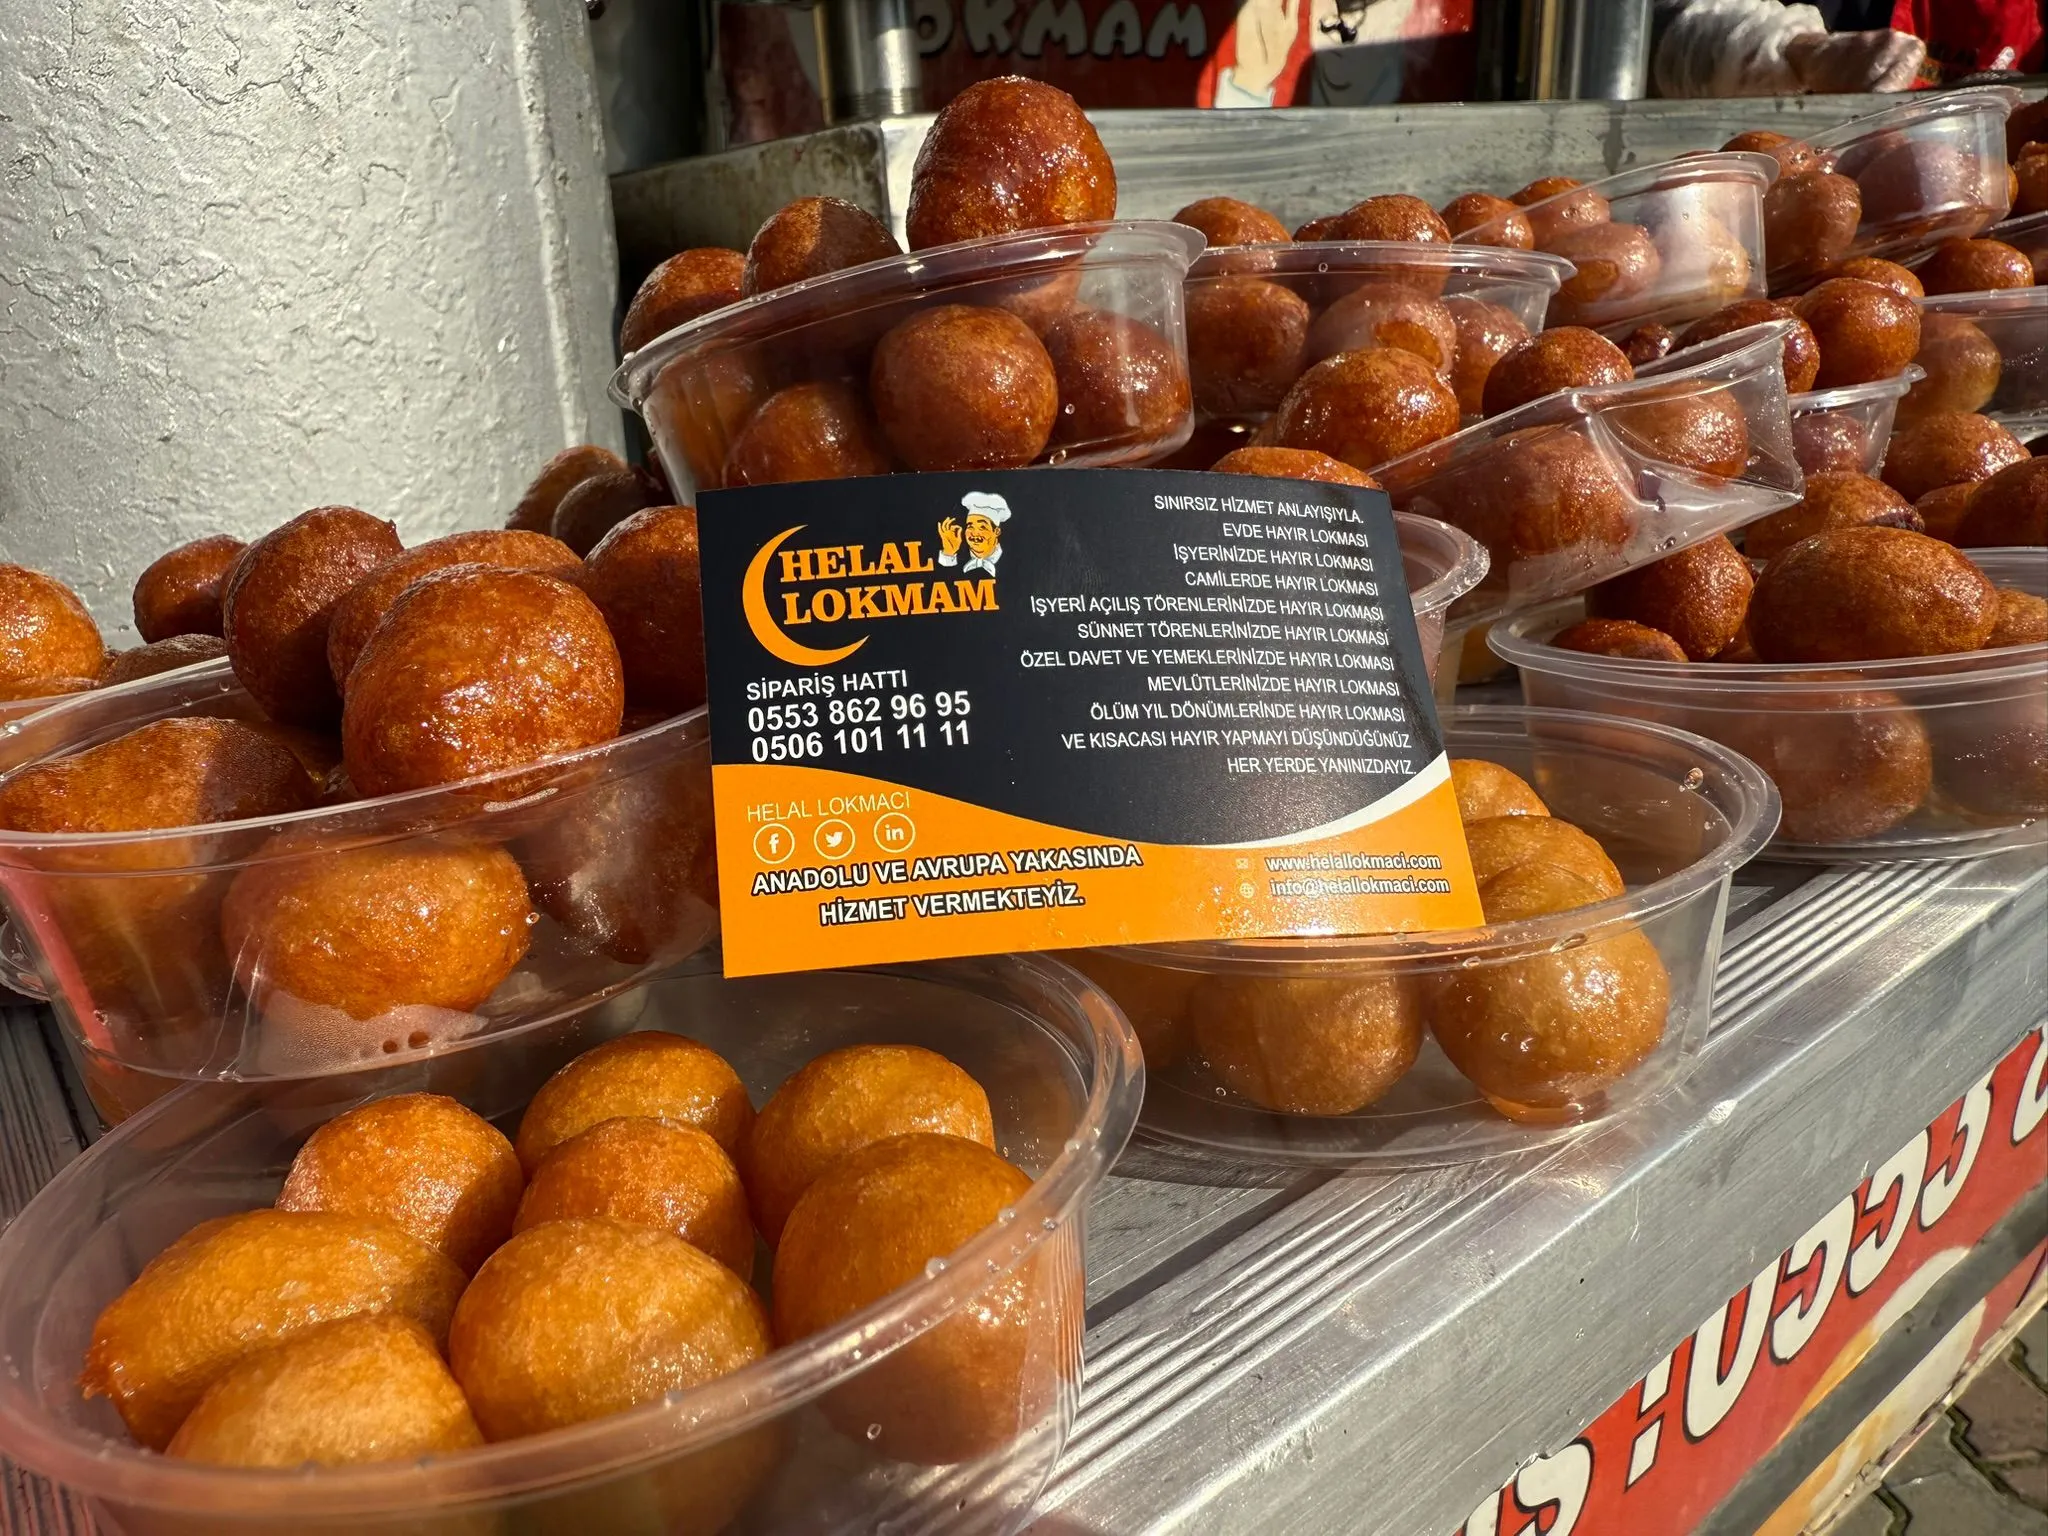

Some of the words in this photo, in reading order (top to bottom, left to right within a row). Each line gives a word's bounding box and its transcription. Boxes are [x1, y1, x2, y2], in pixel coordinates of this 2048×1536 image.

[1154, 495, 1219, 512] SINIRSIZ
[1221, 496, 1274, 515] HİZMET
[1277, 502, 1364, 524] ANLAYIŞIYLA.
[1223, 522, 1263, 539] EVDE
[1266, 525, 1308, 542] HAYIR
[1310, 529, 1369, 548] LOKMASI
[777, 541, 934, 583] HELAL
[1173, 543, 1268, 564] İŞYERİNİZDE
[1270, 551, 1313, 567] HAYIR
[1315, 554, 1374, 572] LOKMASI
[1185, 570, 1272, 589] CAMİLERDE
[1275, 575, 1317, 592] HAYIR
[1320, 578, 1379, 597] LOKMASI
[781, 578, 1000, 625] LOKMAM
[1030, 595, 1086, 617] İŞYERİ
[1089, 596, 1141, 615] AÇILIŞ
[1143, 594, 1277, 615] TÖRENLERİNİZDE
[1279, 600, 1323, 617] HAYIR
[1325, 603, 1384, 621] LOKMASI
[1077, 621, 1144, 639] SÜNNET
[1147, 620, 1282, 640] TÖRENLERİNİZDE
[1284, 626, 1328, 642] HAYIR
[1330, 628, 1390, 646] LOKMASI
[1020, 650, 1066, 668] ÖZEL
[1068, 650, 1122, 666] DAVET
[1125, 649, 1149, 665] VE
[1152, 648, 1287, 666] YEMEKLERİNİZDE
[1289, 651, 1333, 668] HAYIR
[1334, 653, 1395, 671] LOKMASI
[746, 672, 836, 701] SİPARİŞ
[842, 669, 908, 693] HATTI
[1147, 673, 1292, 692] MEVLÜTLERİNİZDE
[1294, 678, 1338, 694] HAYIR
[1340, 680, 1400, 697] LOKMASI
[747, 701, 819, 733] 0553
[829, 696, 882, 725] 862
[890, 693, 926, 720] 96
[935, 690, 971, 717] 95
[1090, 702, 1139, 720] ÖLÜM
[1141, 703, 1168, 719] YIL
[1171, 701, 1296, 719] DÖNÜMLERİNDE
[1299, 704, 1343, 720] HAYIR
[1345, 705, 1406, 722] LOKMASI
[751, 731, 823, 763] 0506
[833, 726, 883, 754] 101
[896, 723, 926, 749] 11
[939, 719, 969, 746] 11
[1061, 733, 1087, 750] VE
[1089, 730, 1167, 749] KISACASI
[1171, 730, 1220, 746] HAYIR
[1221, 729, 1288, 746] YAPMAYI
[1291, 728, 1412, 750] DÜŞÜNDÜĞÜNÜZ
[1227, 757, 1261, 774] HER
[1263, 757, 1318, 774] YERDE
[1318, 757, 1417, 775] YANINIZDAYIZ.
[747, 800, 812, 823] HELAL
[817, 791, 911, 816] LOKMACI
[751, 863, 870, 896] ANADOLU
[873, 859, 909, 884] VE
[910, 852, 1008, 881] AVRUPA
[1008, 844, 1143, 873] YAKASINDA
[1265, 851, 1442, 872] www.helallokmaci.com
[1270, 876, 1451, 898] info@helallokmaci.com
[819, 896, 910, 927] HİZMET
[911, 879, 1086, 917] VERMEKTEYİZ.
